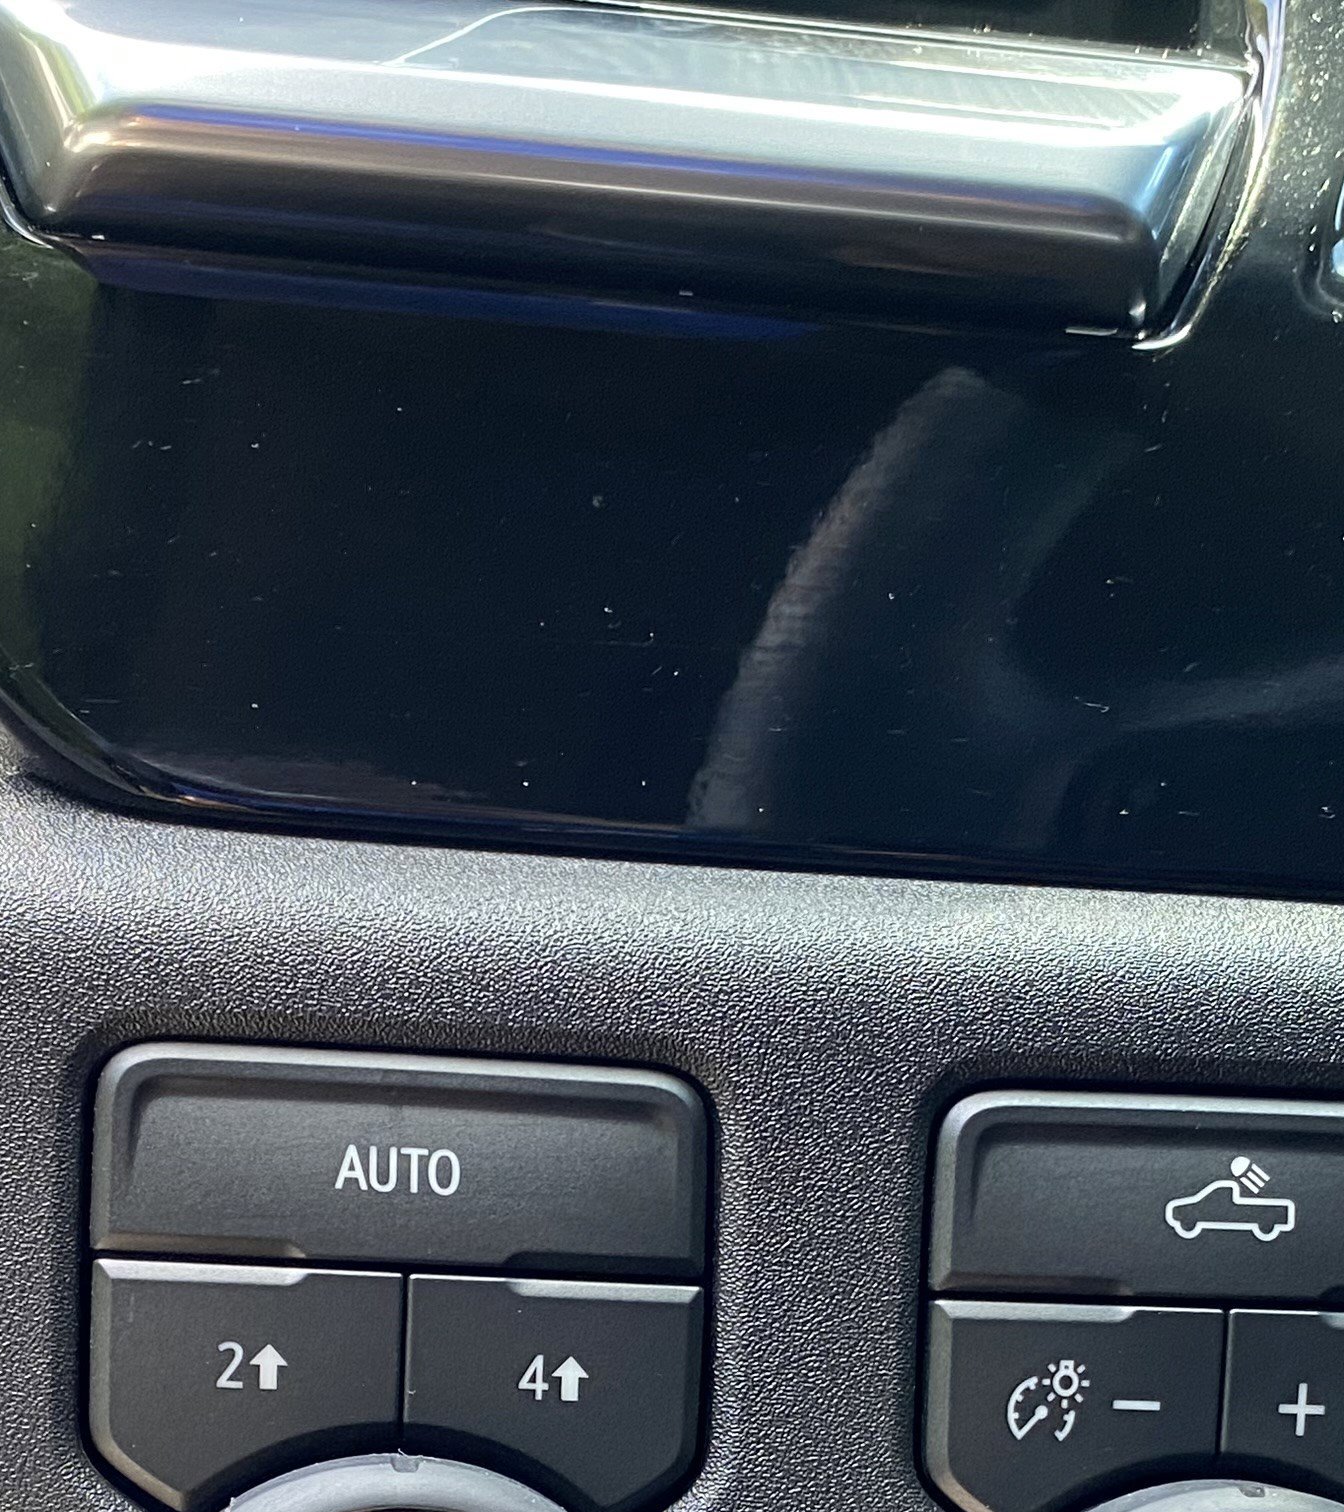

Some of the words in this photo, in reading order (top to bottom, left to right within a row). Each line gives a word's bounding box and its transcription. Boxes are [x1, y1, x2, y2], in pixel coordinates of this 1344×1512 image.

[334, 1143, 461, 1196] AUTO
[215, 1341, 244, 1389] 2
[517, 1354, 549, 1401] 4
